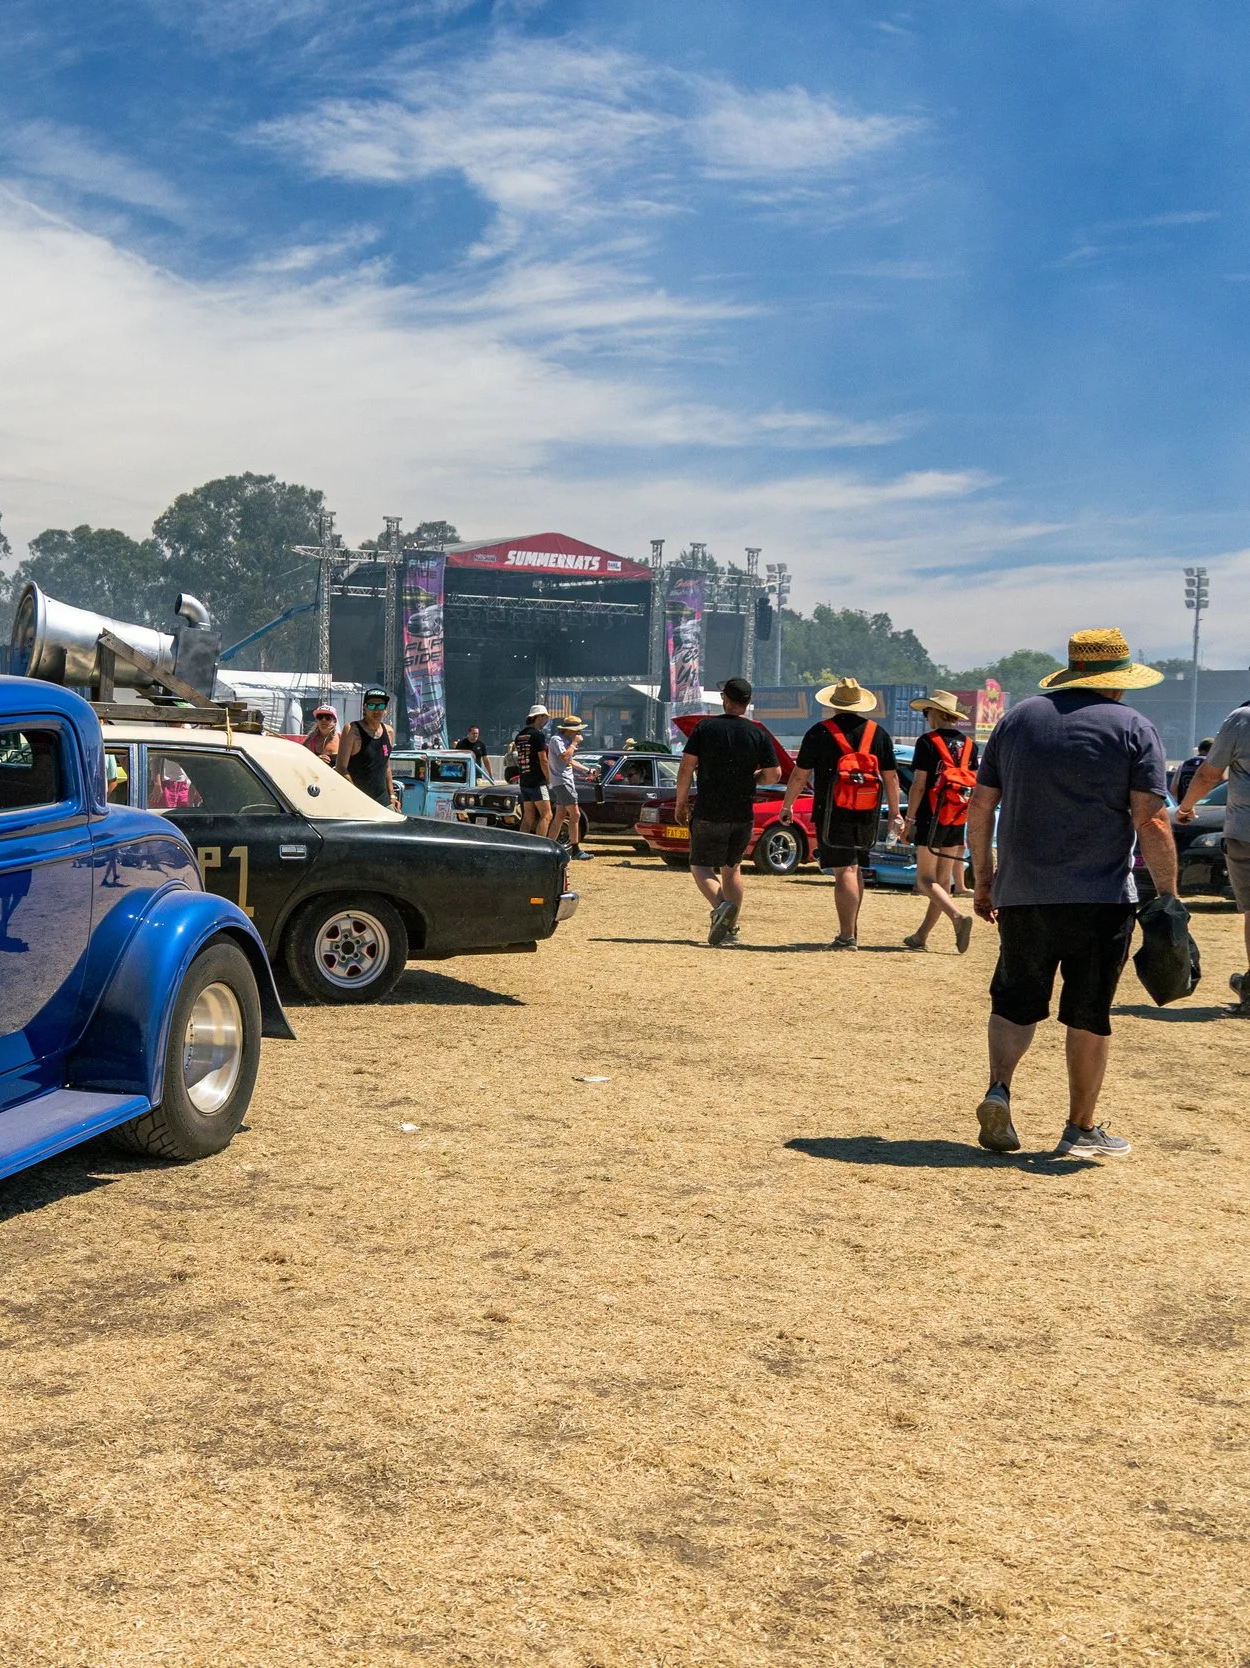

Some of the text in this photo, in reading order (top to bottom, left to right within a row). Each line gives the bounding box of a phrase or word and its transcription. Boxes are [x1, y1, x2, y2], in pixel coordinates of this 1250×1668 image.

[504, 550, 601, 570] SUMMERNATS
[404, 637, 444, 652] FLIP
[403, 651, 441, 667] SIDE
